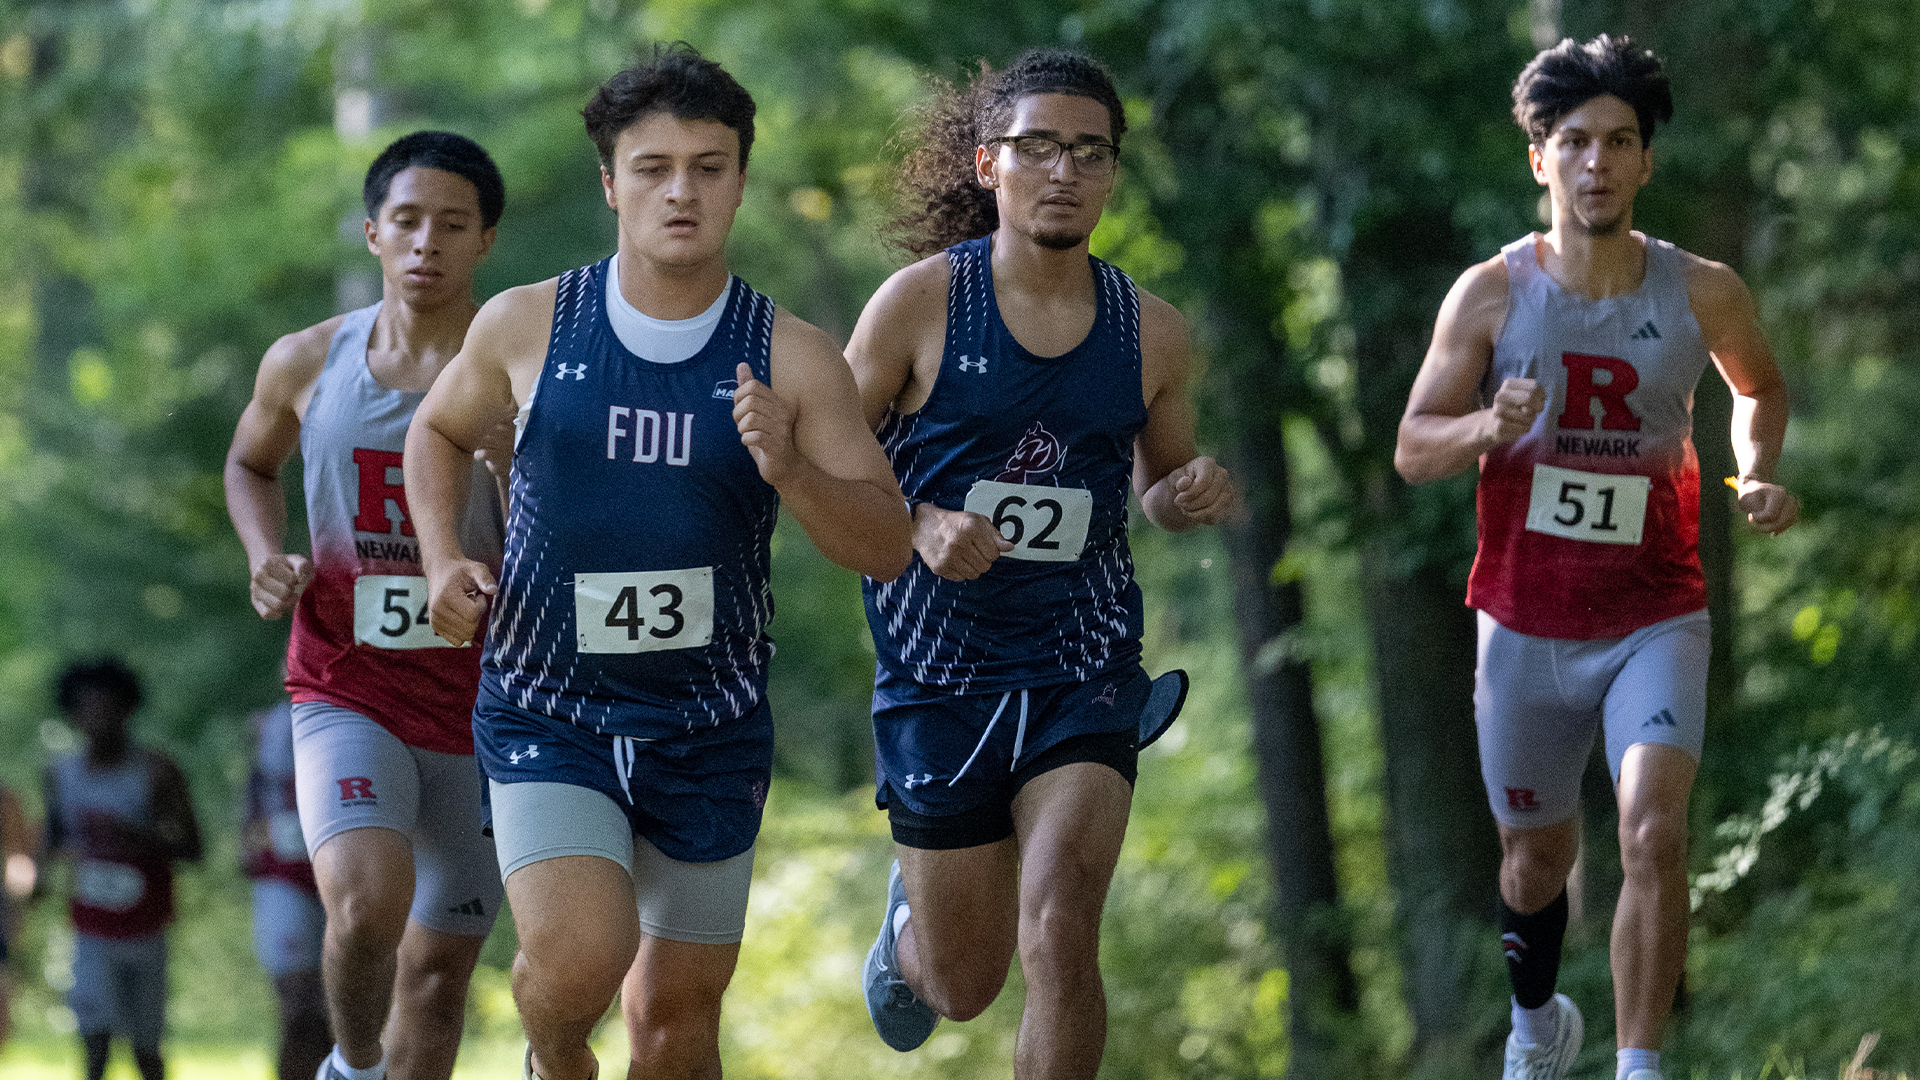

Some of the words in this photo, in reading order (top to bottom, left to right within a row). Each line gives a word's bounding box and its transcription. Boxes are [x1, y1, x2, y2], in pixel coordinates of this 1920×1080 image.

[716, 388, 735, 398] MA
[1558, 352, 1641, 432] R
[607, 405, 694, 467] FDU
[1556, 436, 1641, 457] NEWARK
[992, 495, 1063, 550] 62
[1554, 482, 1618, 531] 51
[605, 583, 685, 641] 43
[337, 777, 377, 800] R
